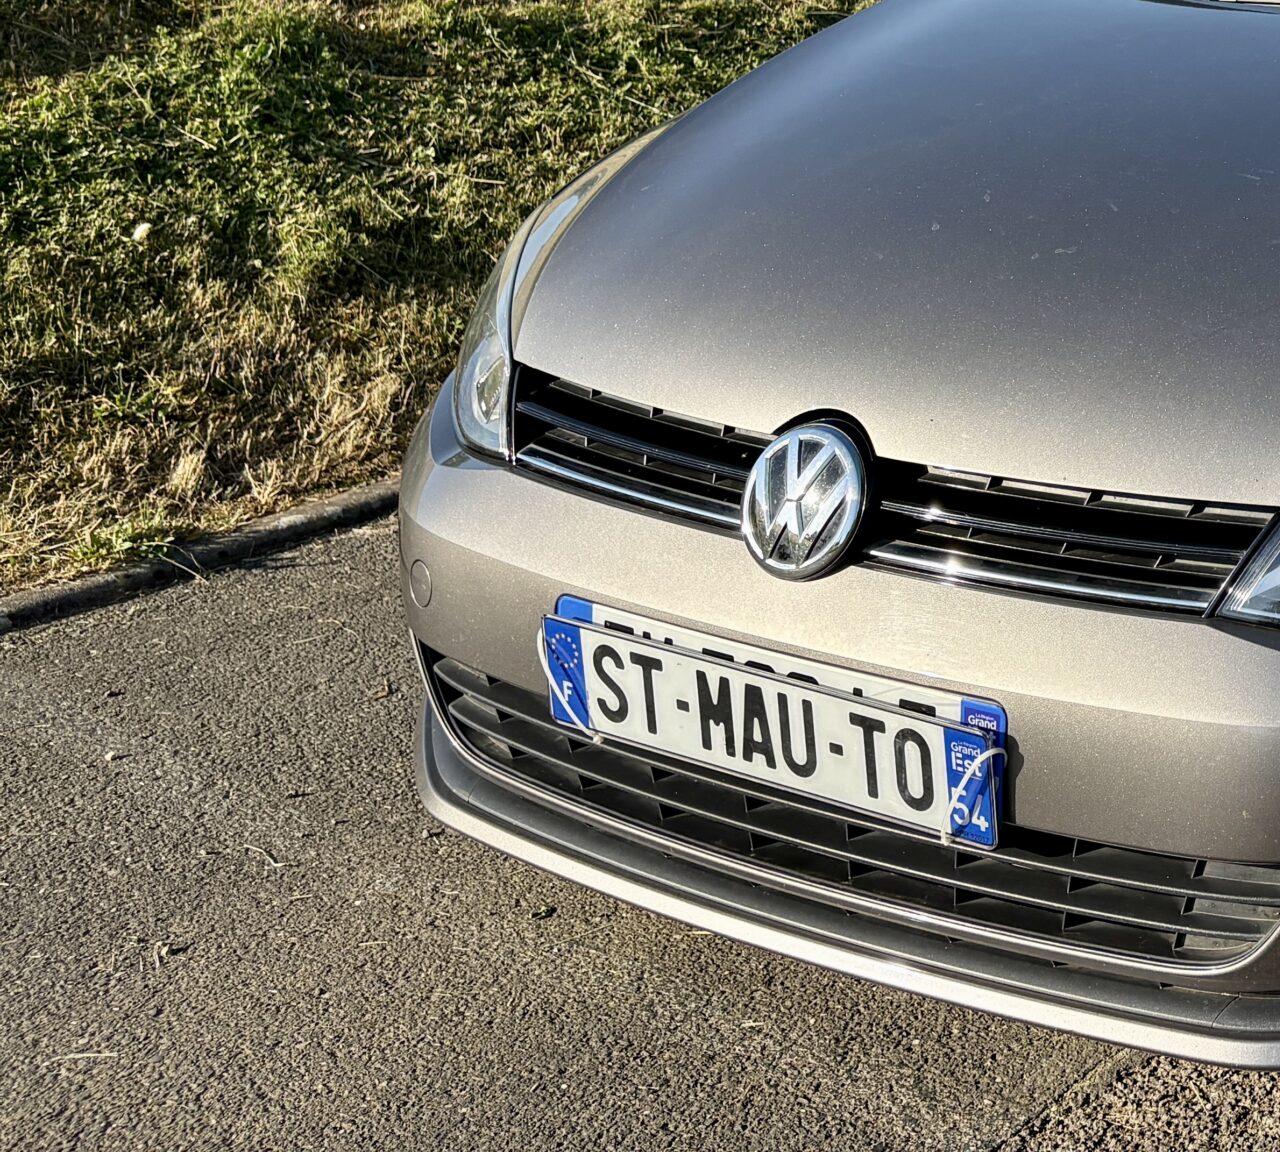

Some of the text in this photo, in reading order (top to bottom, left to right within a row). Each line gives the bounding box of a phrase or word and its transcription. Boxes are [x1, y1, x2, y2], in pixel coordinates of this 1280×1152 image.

[562, 680, 573, 702] F
[593, 645, 934, 811] ST-MAU-TO
[968, 715, 997, 730] Grand
[950, 742, 980, 758] Grand
[951, 787, 989, 832] 54
